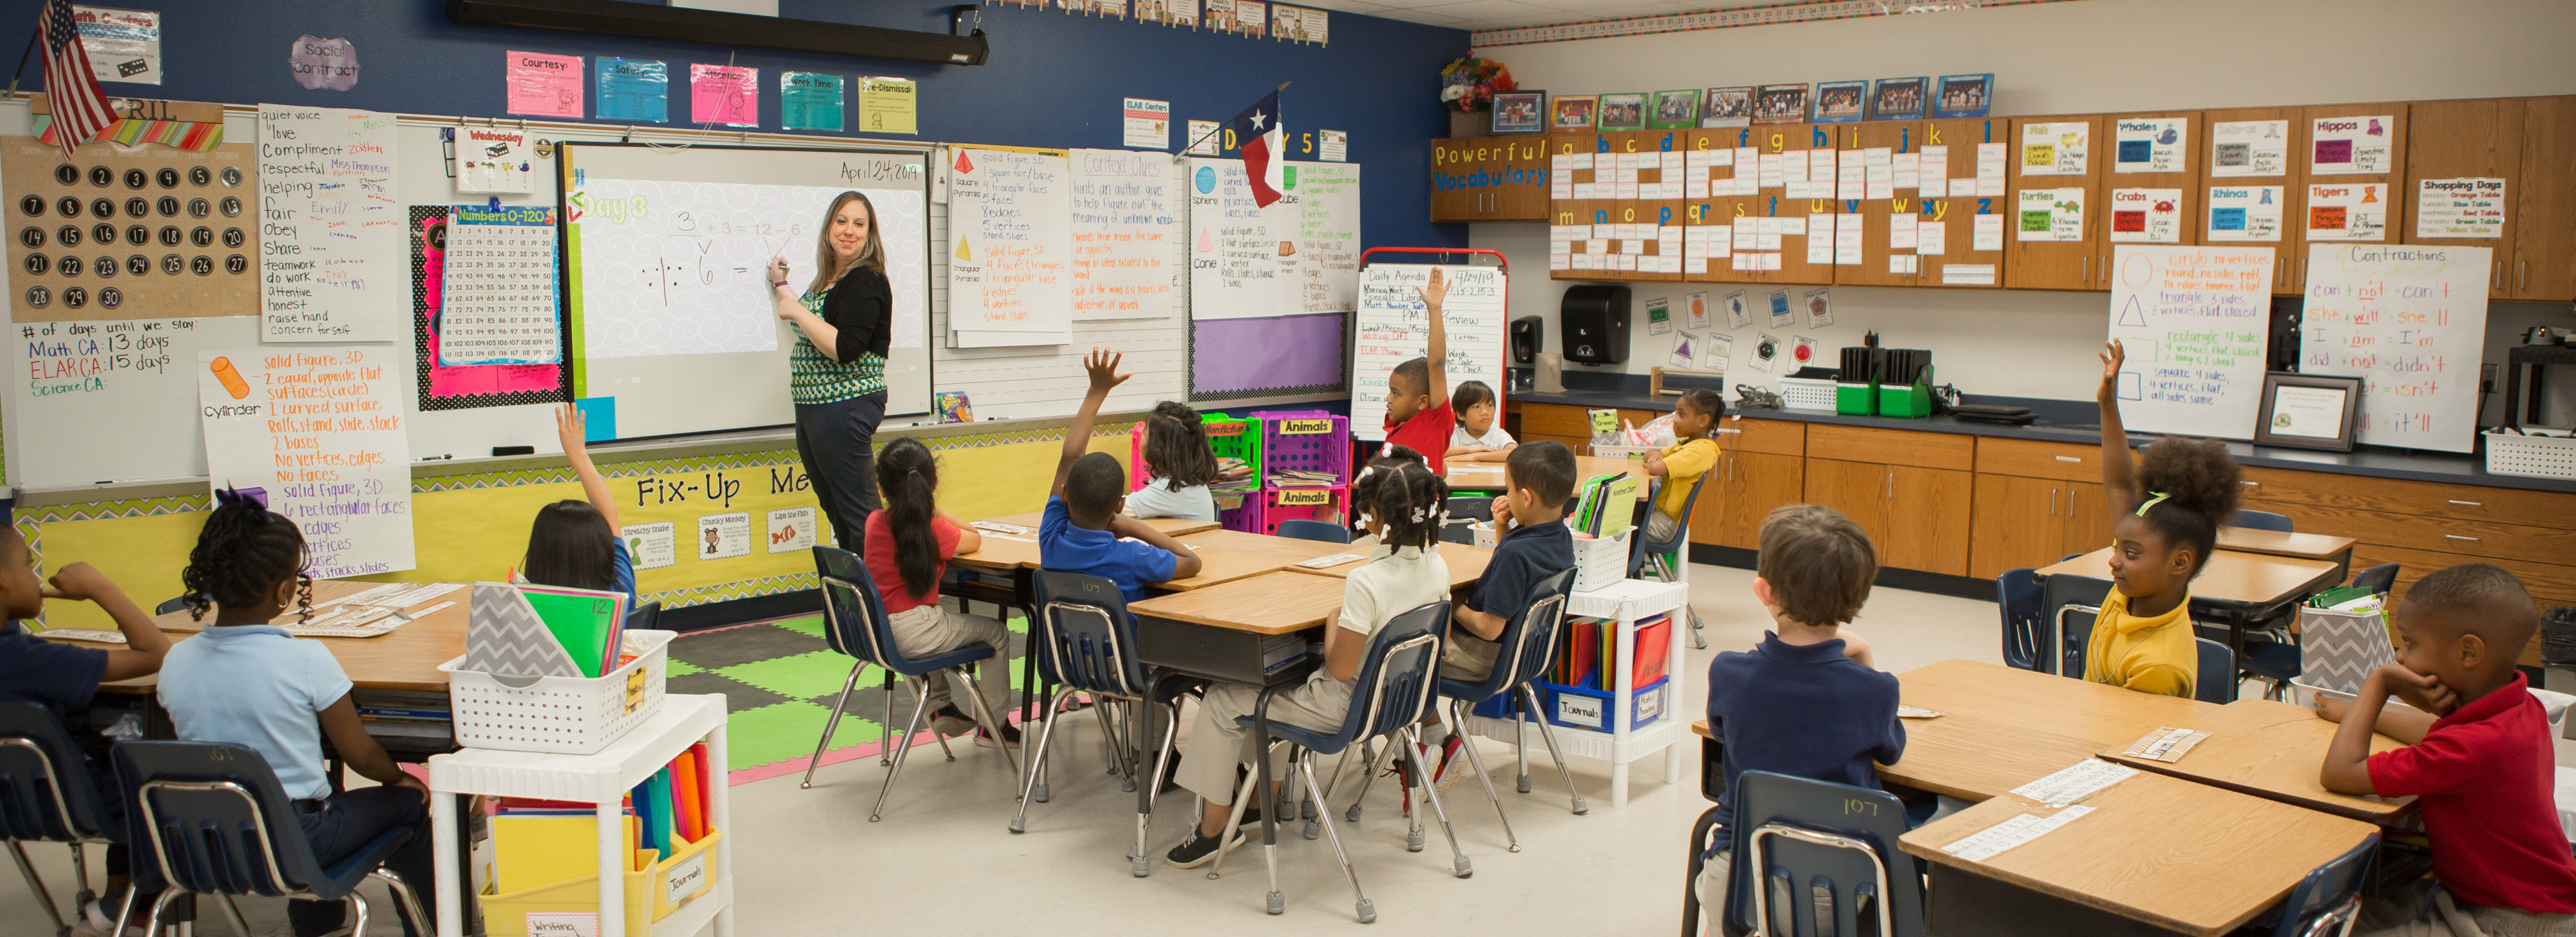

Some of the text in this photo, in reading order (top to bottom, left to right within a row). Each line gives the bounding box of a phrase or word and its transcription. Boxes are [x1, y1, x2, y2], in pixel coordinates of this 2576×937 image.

[306, 43, 345, 58] Social
[293, 62, 357, 77] Contract
[522, 58, 568, 71] Courtesy:
[814, 79, 833, 88] Time:
[862, 83, 912, 93] Pre-Dismissal:
[1127, 100, 1167, 111] ELAR Centers
[262, 111, 291, 130] quiet
[2119, 122, 2157, 131] Whales
[2318, 121, 2357, 132] Hippos
[273, 124, 296, 139] love
[470, 131, 523, 146] Wednesday
[1303, 133, 1312, 153] 5
[263, 144, 343, 160] Compliment
[1435, 140, 1545, 166] Powerful
[263, 161, 325, 178] respectful
[841, 160, 870, 184] April
[1084, 153, 1160, 176] Context Clues
[1434, 166, 1547, 191] Vocabulary
[2424, 181, 2501, 191] Shopping Days
[263, 178, 312, 198] helping
[1074, 180, 1163, 201] hints an author gives
[2213, 189, 2248, 198] Rhinos
[2313, 187, 2349, 198] Tigers
[983, 193, 1014, 204] 5 faces
[1074, 196, 1164, 213] to help figure out the
[1193, 196, 1218, 205] Sphere
[2115, 193, 2146, 201] Crabs
[265, 196, 296, 220] fair
[312, 200, 348, 214] Emily
[580, 194, 647, 225] Day 3
[1244, 208, 1260, 217] faces
[459, 209, 545, 222] Numbers 0-120
[678, 212, 695, 231] 3
[1073, 212, 1173, 229] meaning of unknown words
[265, 223, 296, 240] Obey
[721, 223, 800, 236] 3 12 6
[2352, 245, 2447, 262] Contractions
[32, 258, 45, 271] 21
[264, 259, 316, 270] teamwork
[1194, 259, 1217, 269] Cone
[267, 272, 310, 283] do work
[1229, 279, 1242, 288] base
[1369, 270, 1494, 285] Daily Agenda 4/24/19
[33, 292, 46, 303] 28
[105, 292, 117, 303] 30
[269, 287, 312, 298] attentive
[2402, 282, 2449, 298] can't
[269, 298, 307, 311] honest
[1119, 299, 1139, 309] adverb
[2225, 305, 2257, 317] closed
[1403, 309, 1419, 321] PM
[2398, 308, 2447, 326] she'll
[23, 327, 35, 338] #
[43, 323, 57, 336] of
[70, 323, 96, 337] days
[107, 323, 135, 332] until
[144, 323, 162, 331] we
[271, 323, 350, 335] concern for self
[30, 334, 169, 358] Math CA: 13 days
[31, 354, 169, 379] ELAR CA: 15 days
[265, 351, 363, 371] solid figure, 3D
[2310, 352, 2445, 372] did didn't
[265, 364, 381, 388] 2 equal, opposite flat
[31, 377, 107, 397] Science CA:
[2396, 381, 2438, 396] isn't
[2152, 390, 2213, 405] all sides same
[268, 415, 399, 433] Rolls, stand, slide, stack
[1205, 424, 1244, 433] Nonfiction
[1285, 421, 1328, 431] Animals
[638, 472, 739, 507] Fix-Up
[1284, 491, 1325, 502] Animals
[1613, 487, 1626, 496] Hundred
[702, 518, 724, 526] Chunky
[623, 527, 650, 536] Stretchy
[591, 599, 609, 615] 12
[1561, 701, 1598, 718] Journals
[670, 866, 702, 891] Journals
[533, 921, 578, 934] Writing
